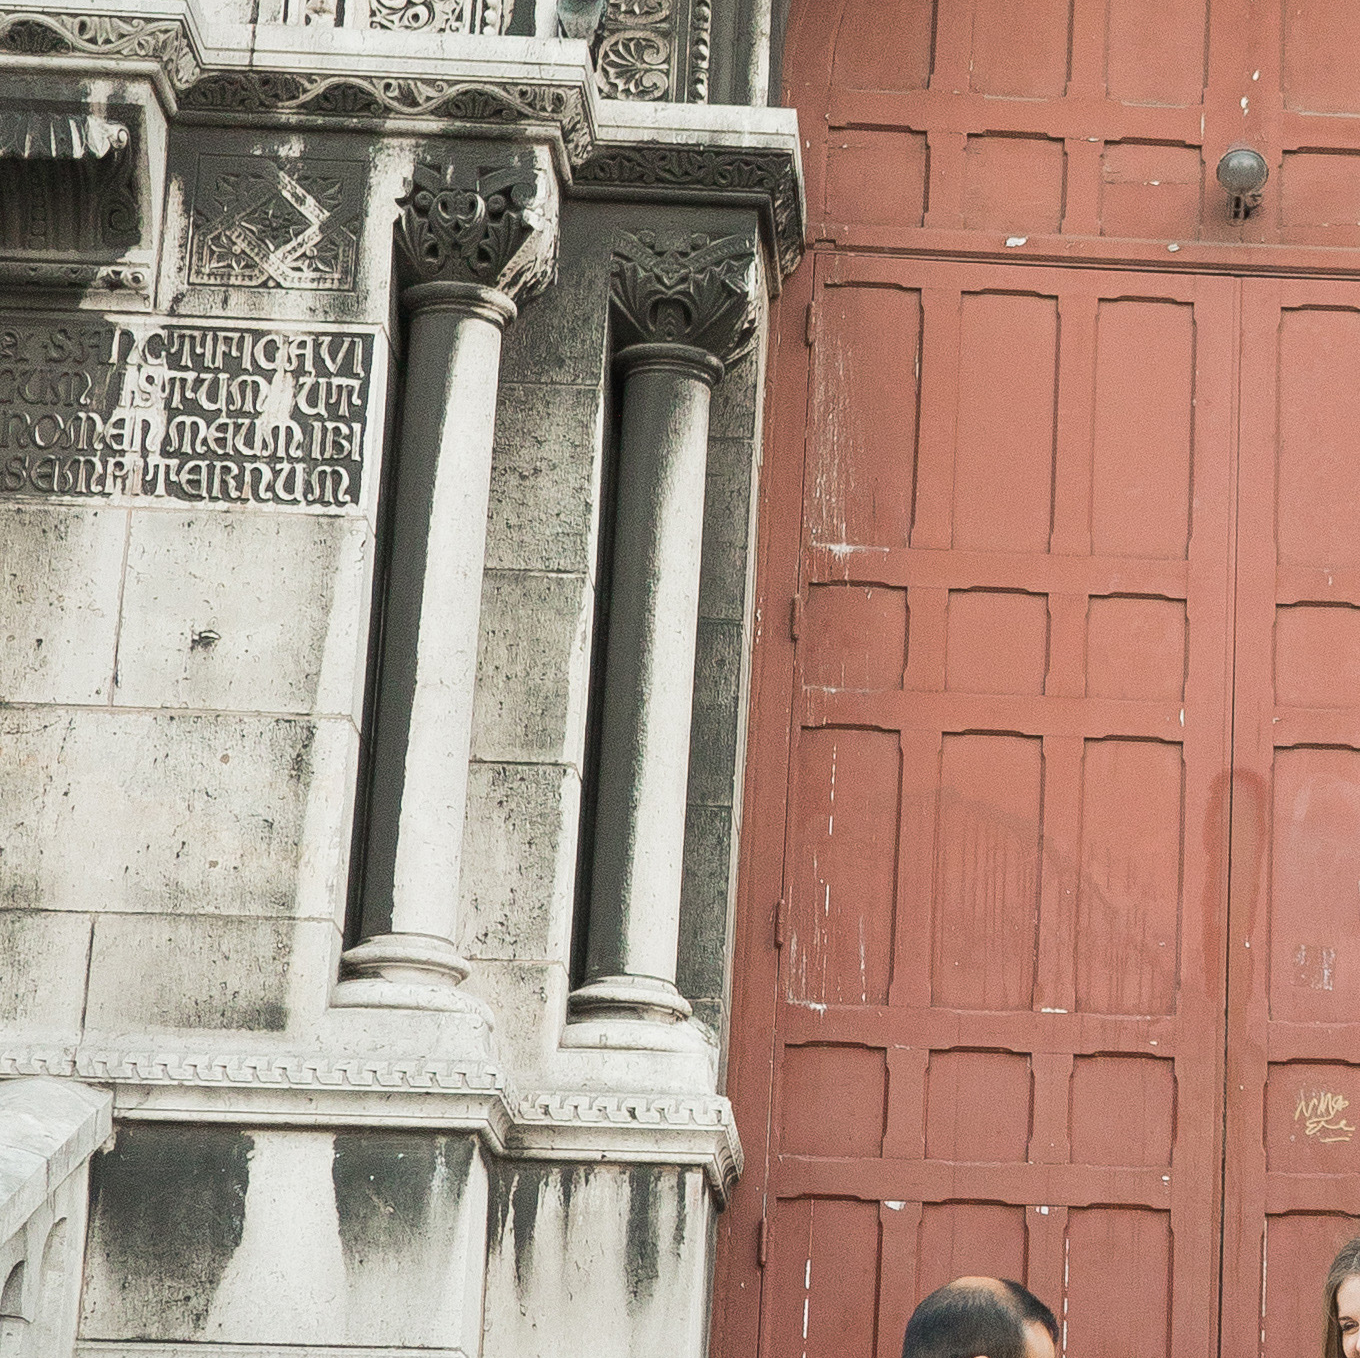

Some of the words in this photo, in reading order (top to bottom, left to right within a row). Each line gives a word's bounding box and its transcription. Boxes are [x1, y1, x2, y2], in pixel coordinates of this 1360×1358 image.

[119, 366, 272, 415] ISTUM
[296, 372, 363, 418] UT
[165, 415, 304, 459] MEUM
[310, 420, 362, 462] IBI
[4, 454, 352, 506] SEMPITERNUM
